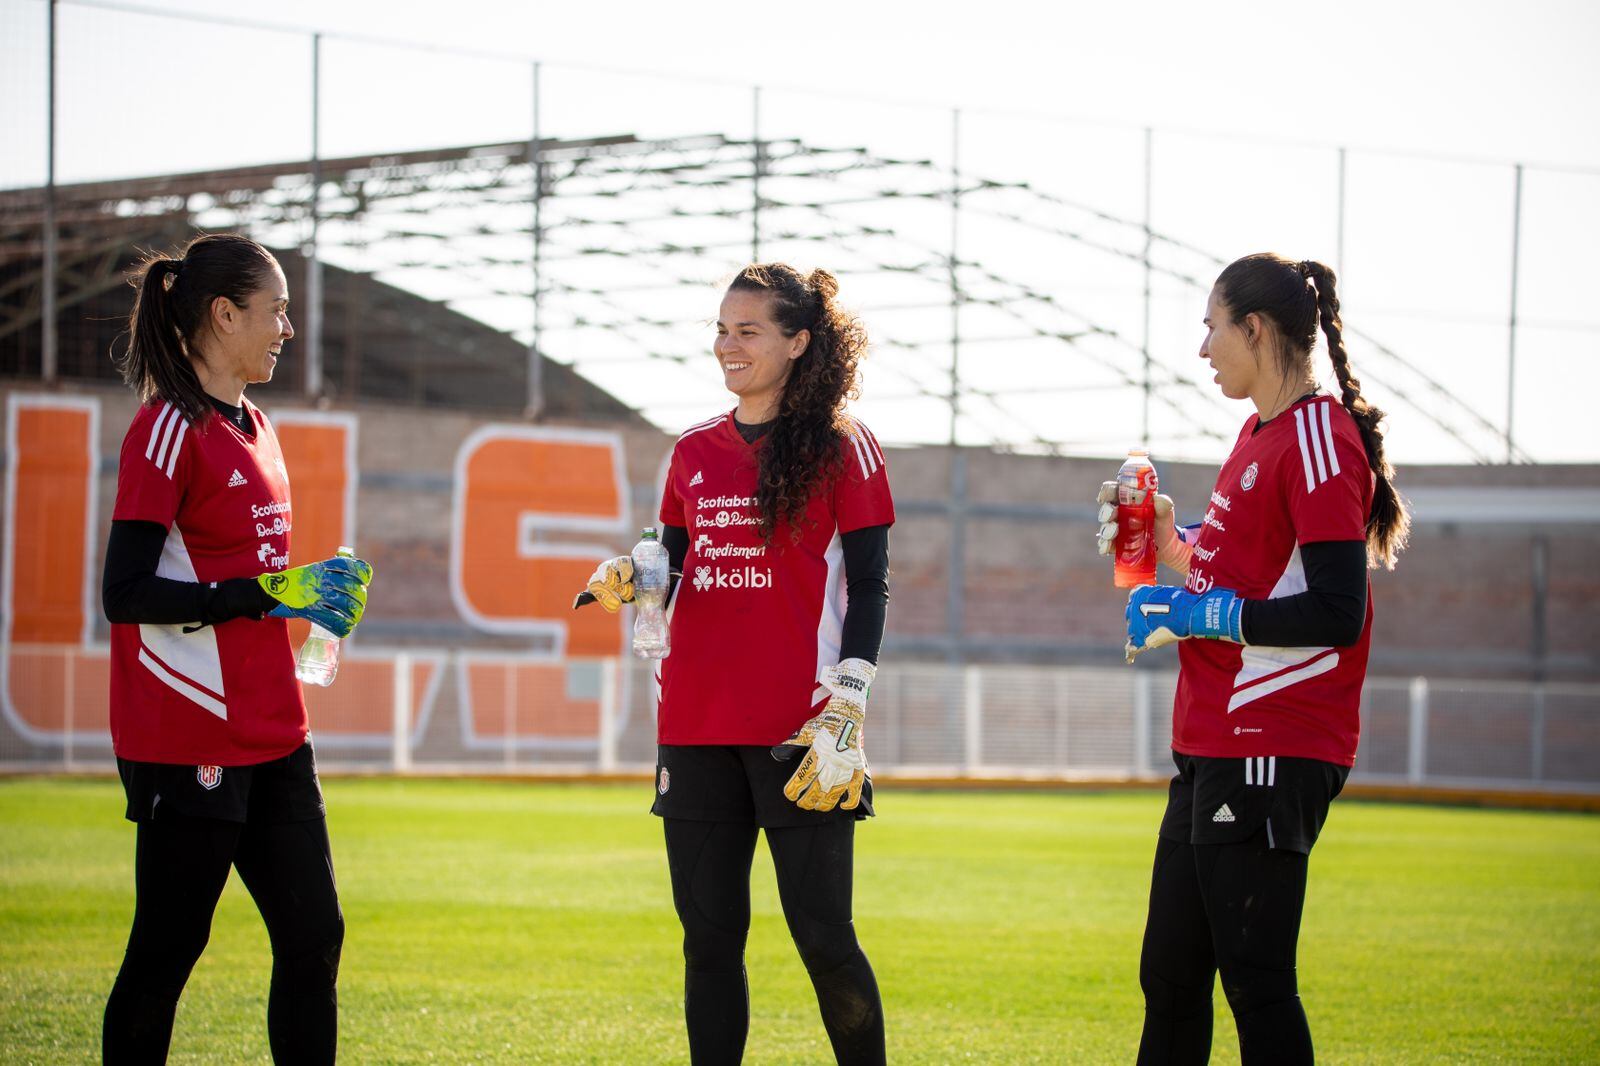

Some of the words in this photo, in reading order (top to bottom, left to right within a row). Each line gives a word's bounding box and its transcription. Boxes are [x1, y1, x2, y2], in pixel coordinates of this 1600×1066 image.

[696, 514, 716, 528] Dos
[715, 566, 772, 588] kölbi
[1185, 567, 1214, 594] ölbi
